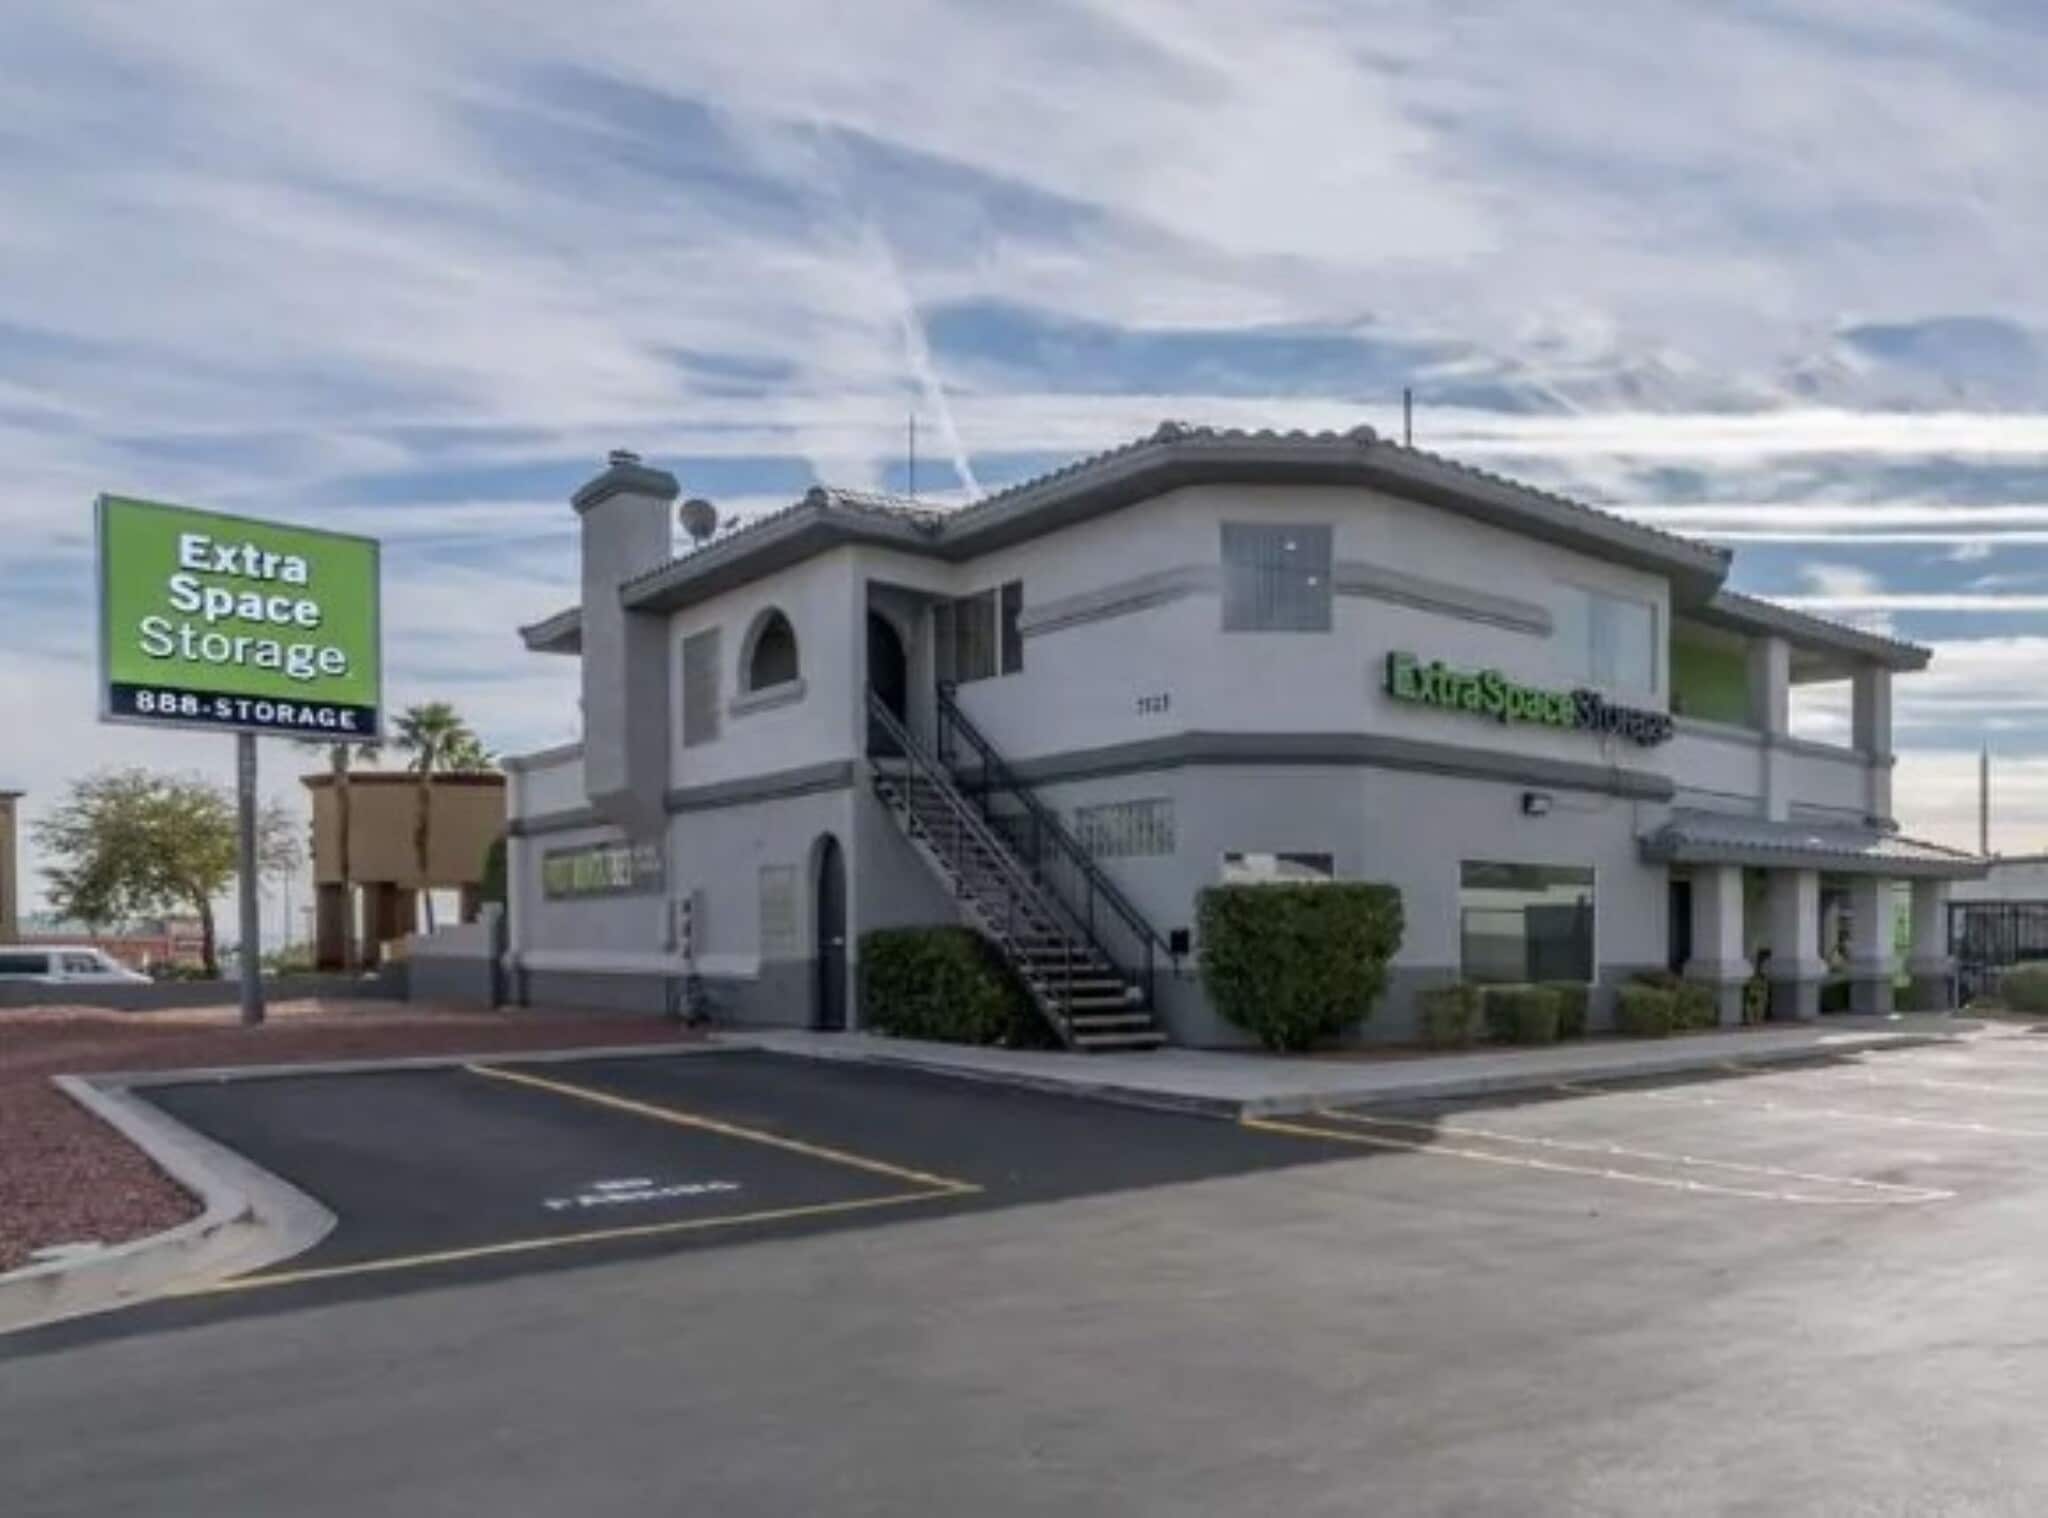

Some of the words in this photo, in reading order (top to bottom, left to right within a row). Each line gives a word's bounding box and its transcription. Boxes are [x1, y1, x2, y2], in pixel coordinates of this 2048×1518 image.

[179, 533, 308, 584] Extra
[168, 572, 321, 627] Space
[139, 615, 347, 680] Storage
[135, 690, 357, 731] 888-STORAGE
